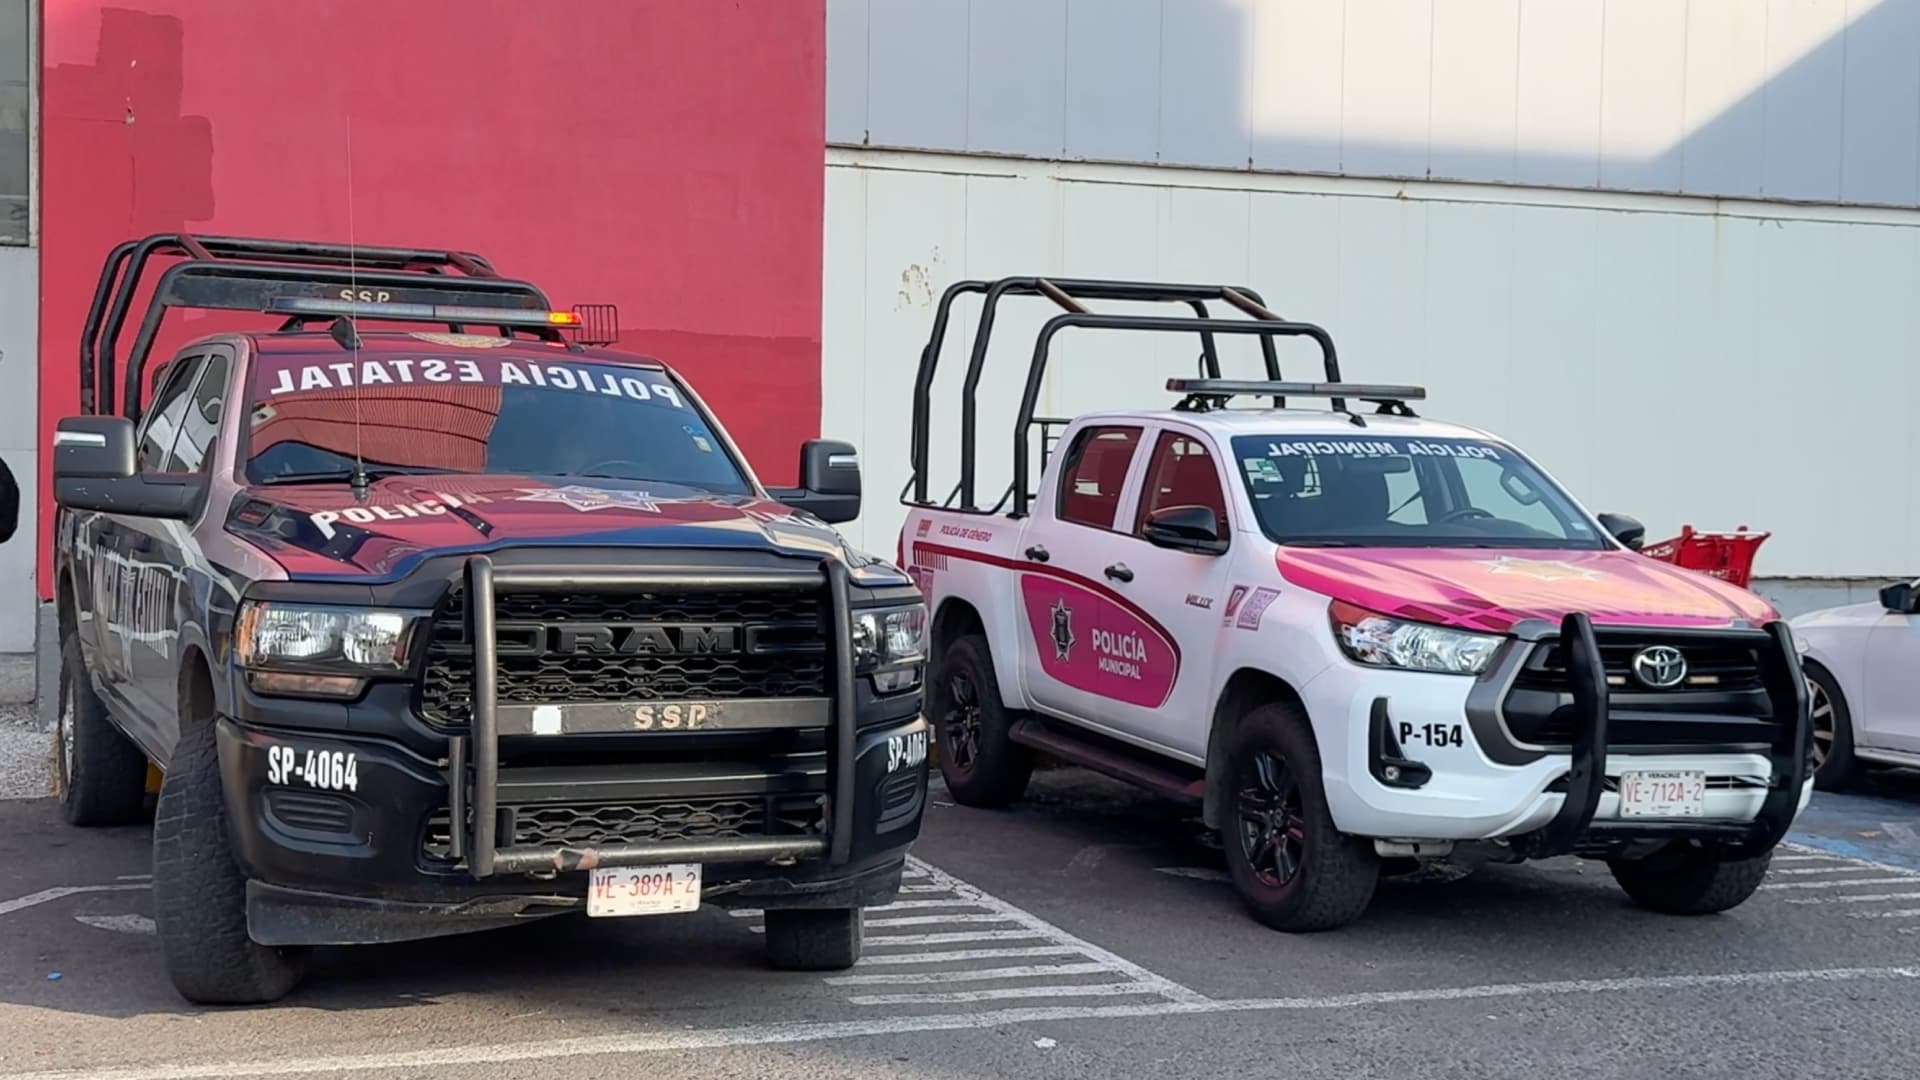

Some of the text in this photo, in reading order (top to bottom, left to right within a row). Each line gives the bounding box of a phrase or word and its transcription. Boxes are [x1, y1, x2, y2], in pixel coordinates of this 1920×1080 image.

[556, 624, 740, 655] RAM
[1091, 628, 1148, 663] POLICÍA
[1098, 656, 1142, 681] MUNICIPAL
[1399, 721, 1464, 748] P-154
[267, 744, 358, 793] SP-4064
[1625, 781, 1702, 803] VE-712A-2
[595, 870, 697, 900] VE-389A-2
